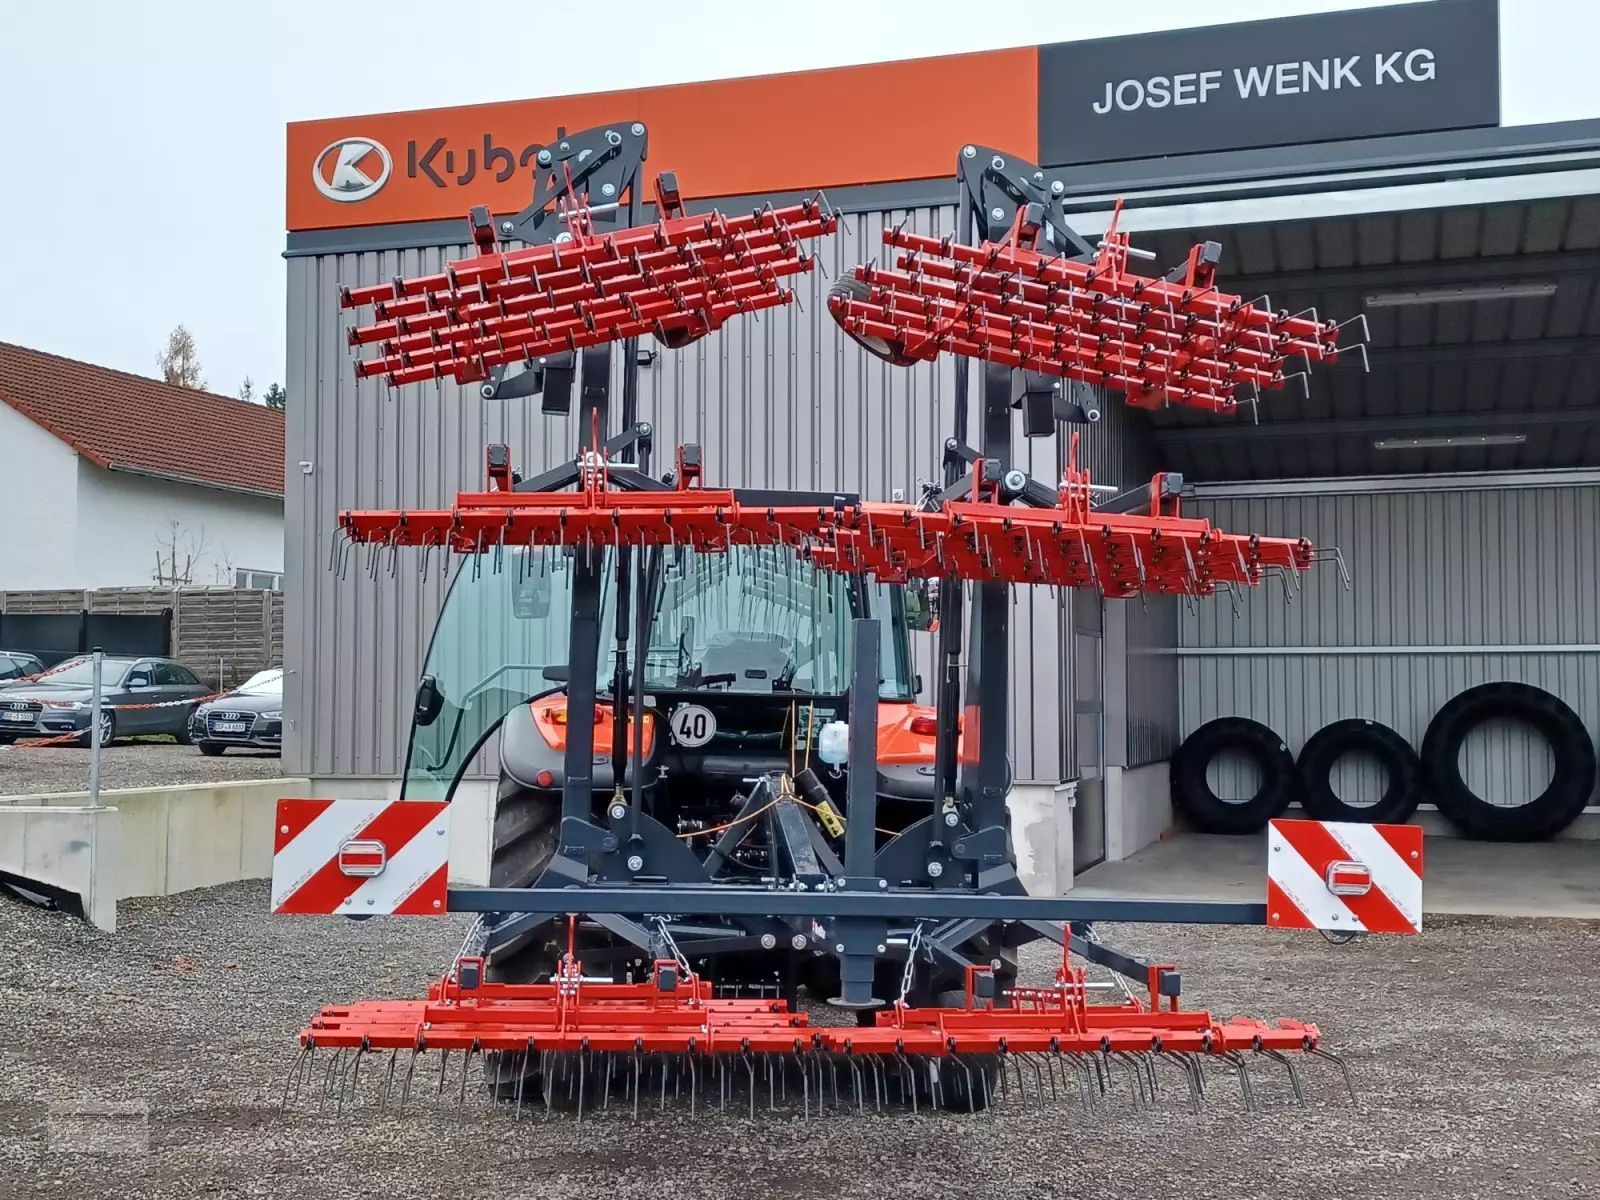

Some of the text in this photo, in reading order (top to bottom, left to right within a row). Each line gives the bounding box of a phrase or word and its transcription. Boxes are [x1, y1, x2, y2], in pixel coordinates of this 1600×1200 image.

[1092, 48, 1436, 114] JOSEF WENK KG
[407, 126, 566, 188] Kub
[679, 713, 707, 739] 40
